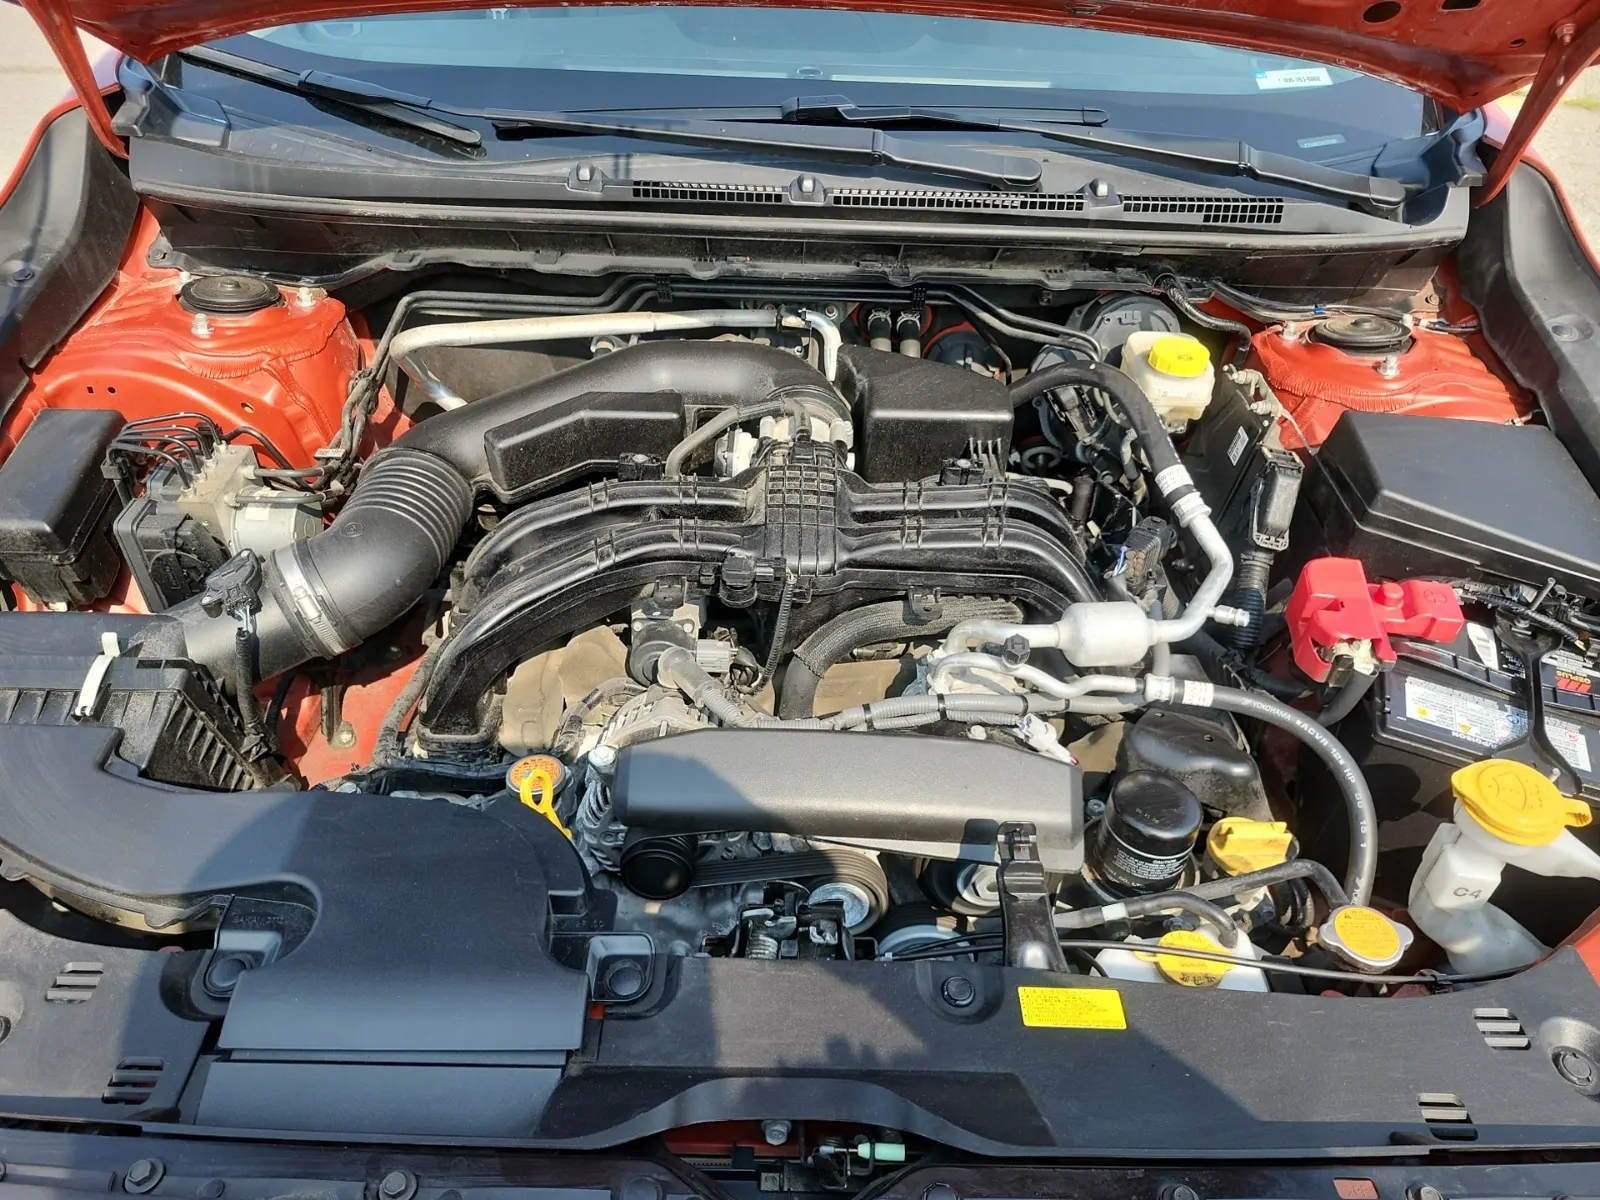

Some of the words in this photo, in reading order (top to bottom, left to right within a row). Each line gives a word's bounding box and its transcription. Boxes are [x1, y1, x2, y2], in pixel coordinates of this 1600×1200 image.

[1252, 701, 1291, 720] YOKOHAMA
[1343, 768, 1356, 783] HP
[1453, 887, 1481, 898] C4
